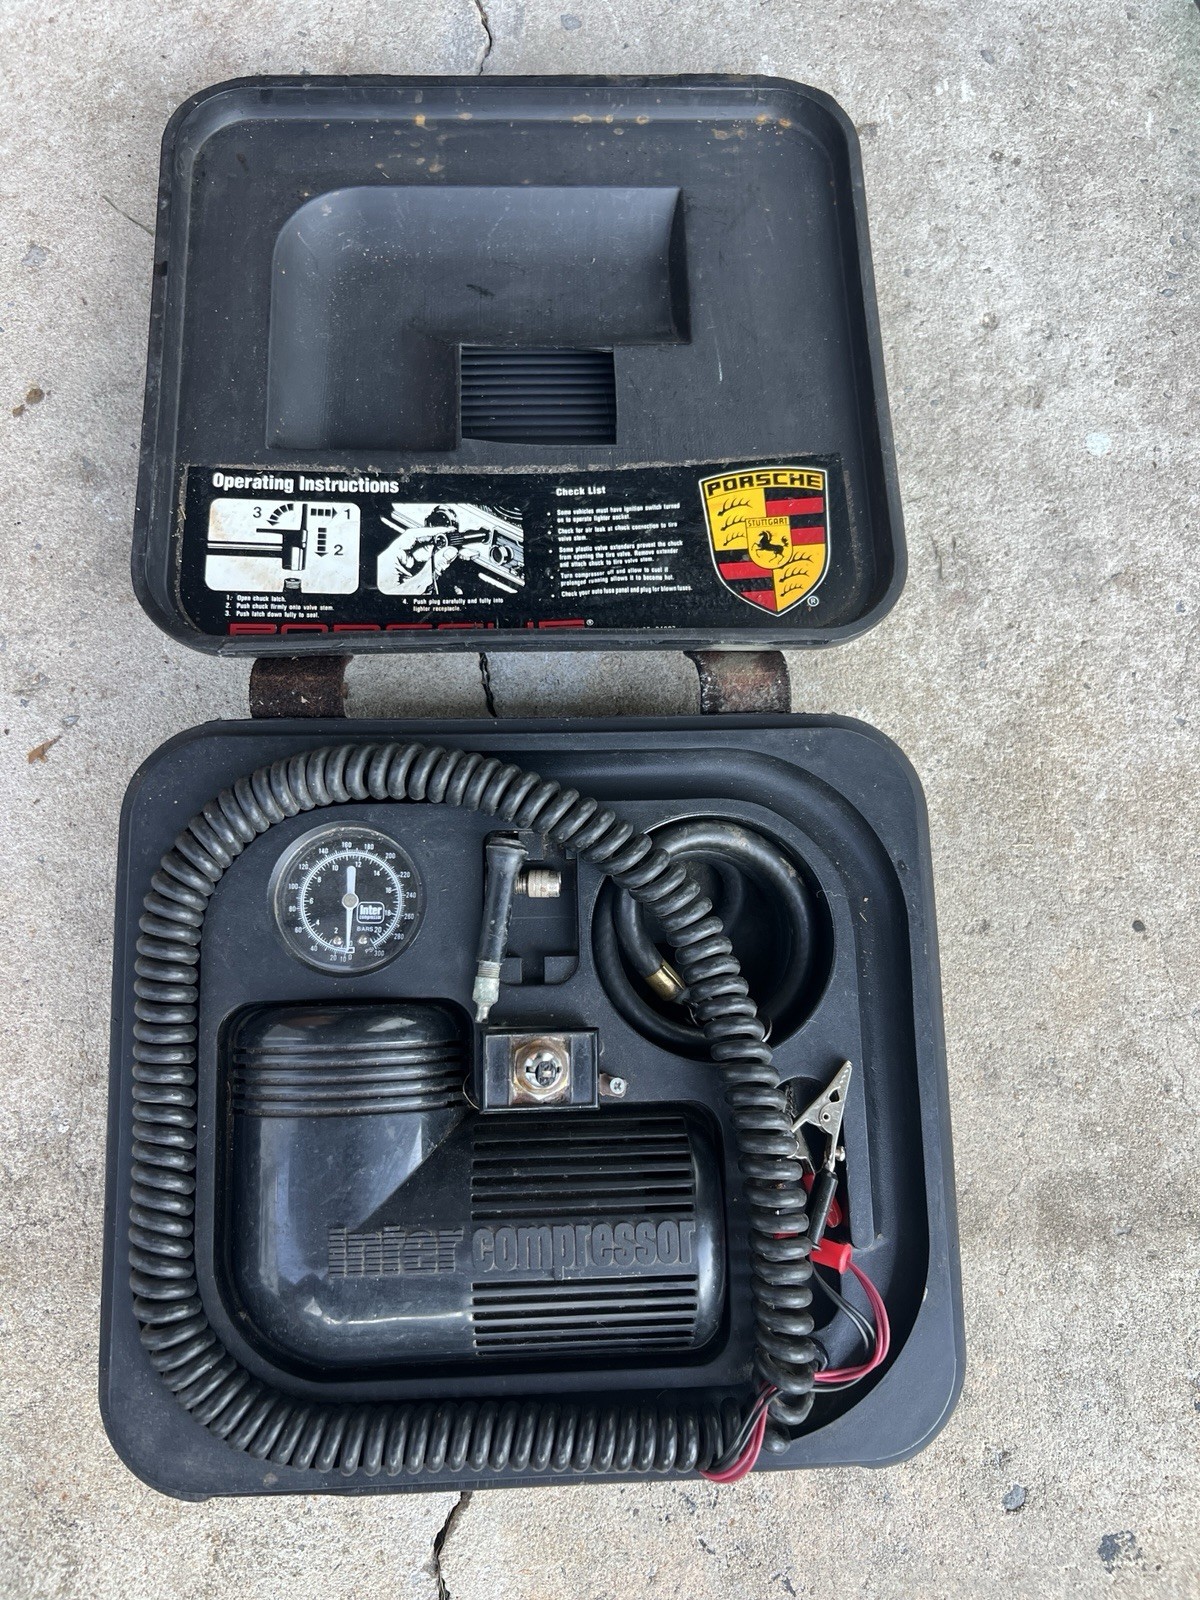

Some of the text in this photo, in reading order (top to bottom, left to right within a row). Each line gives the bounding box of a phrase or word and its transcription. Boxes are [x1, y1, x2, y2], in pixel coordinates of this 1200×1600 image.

[213, 472, 399, 493] Operating Instructions
[707, 473, 821, 496] PORSCHE
[556, 486, 606, 496] Check List
[253, 507, 262, 518] 3
[344, 509, 351, 519] 1
[748, 517, 787, 526] STUTTGART
[334, 545, 343, 555] 2
[561, 579, 586, 587] prolonged
[472, 1220, 695, 1281] compressor
